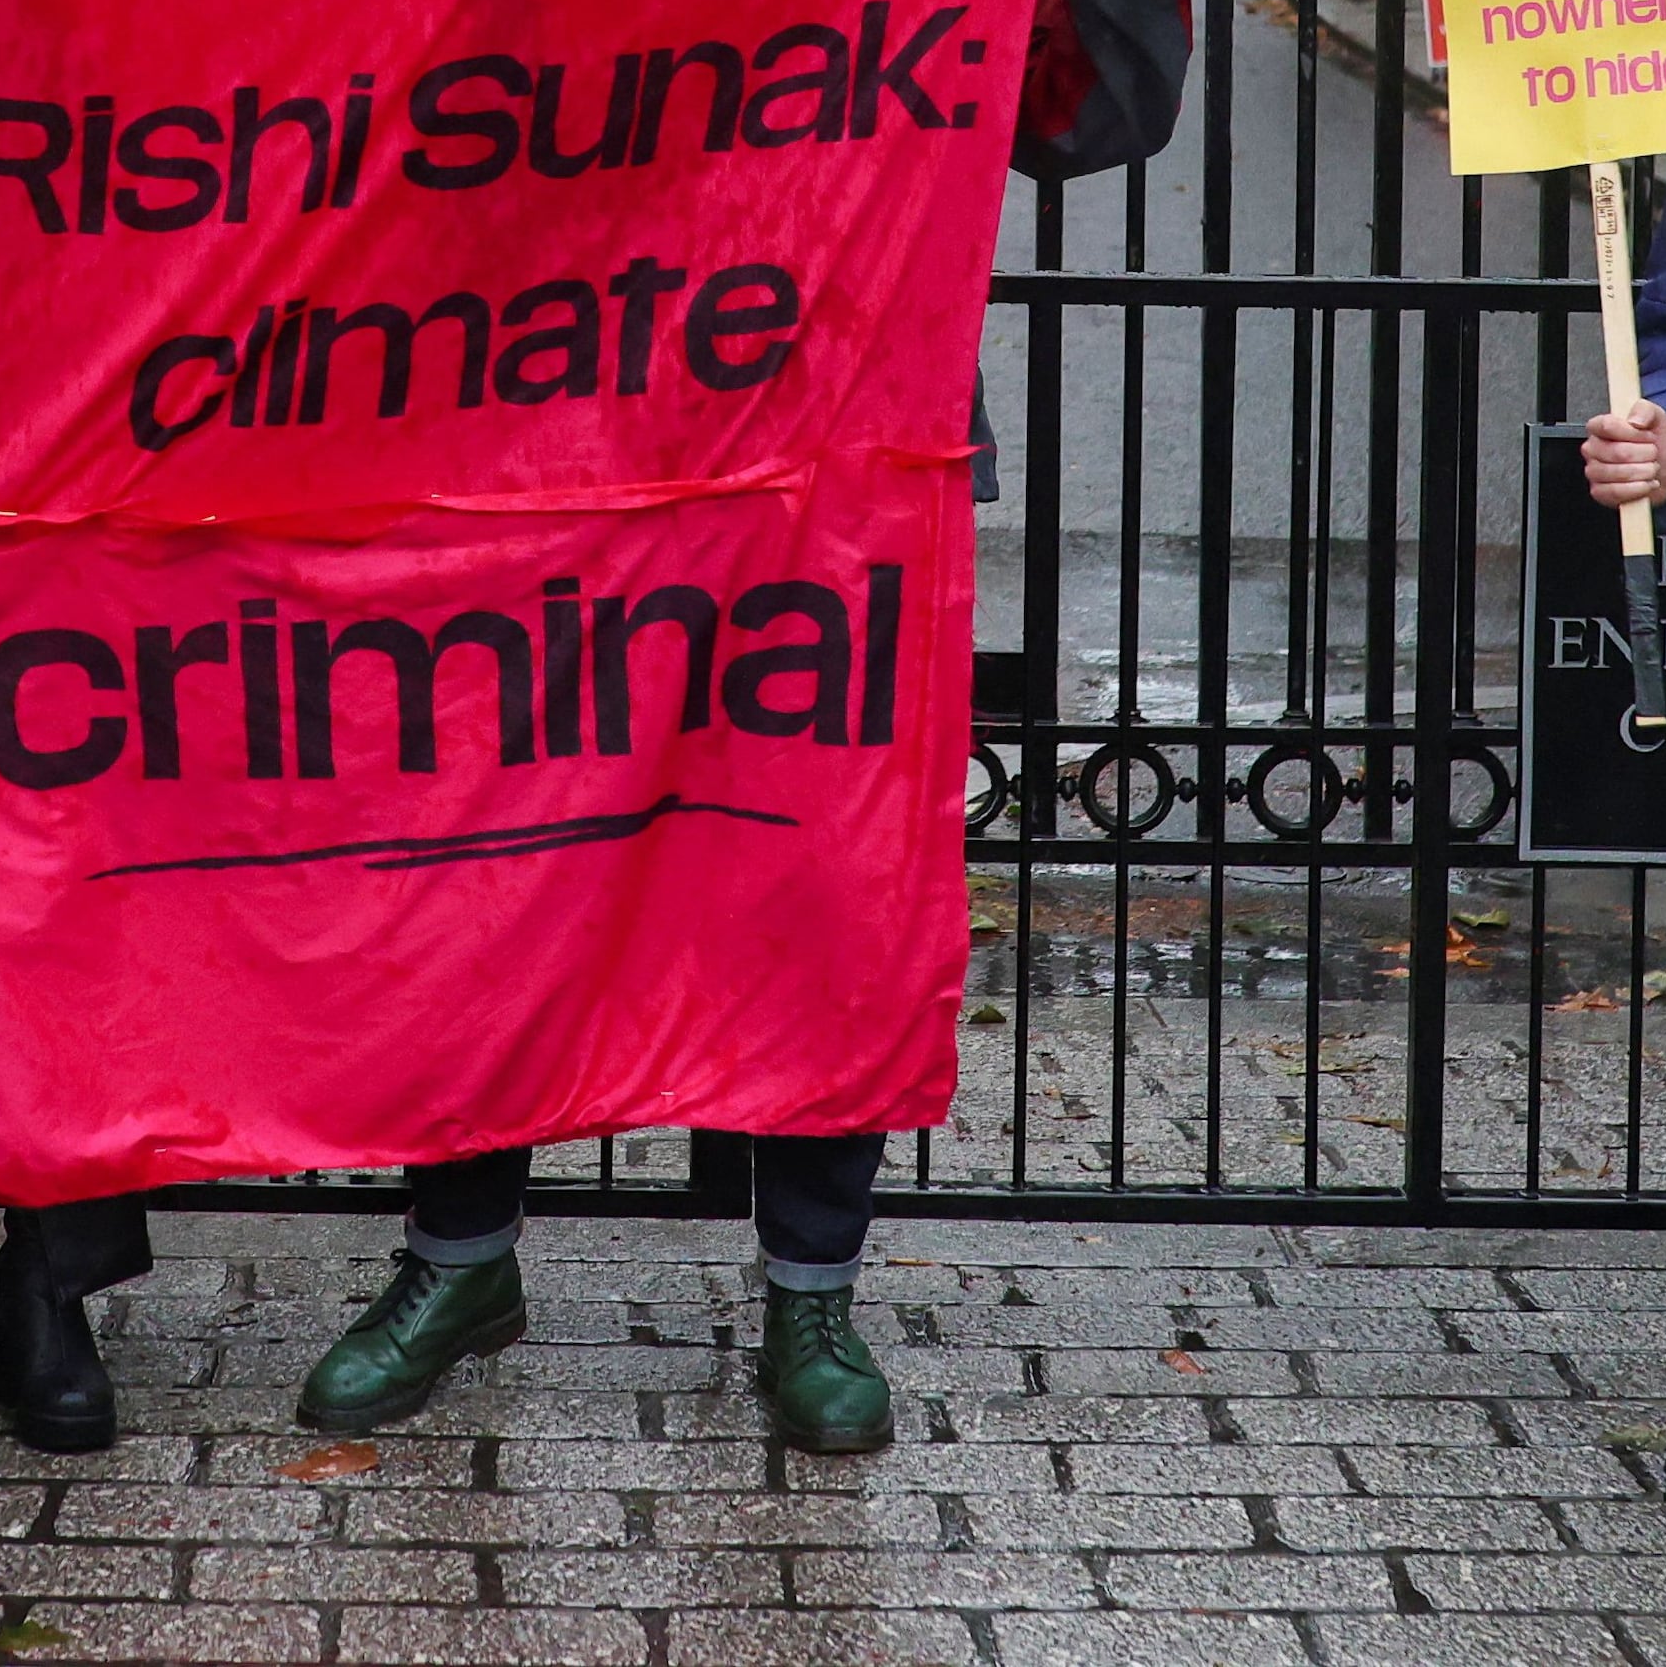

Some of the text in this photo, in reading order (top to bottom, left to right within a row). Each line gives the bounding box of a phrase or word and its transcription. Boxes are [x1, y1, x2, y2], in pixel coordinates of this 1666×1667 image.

[400, 0, 987, 192] Sunak:
[1522, 65, 1577, 106] to
[128, 255, 802, 454] climate
